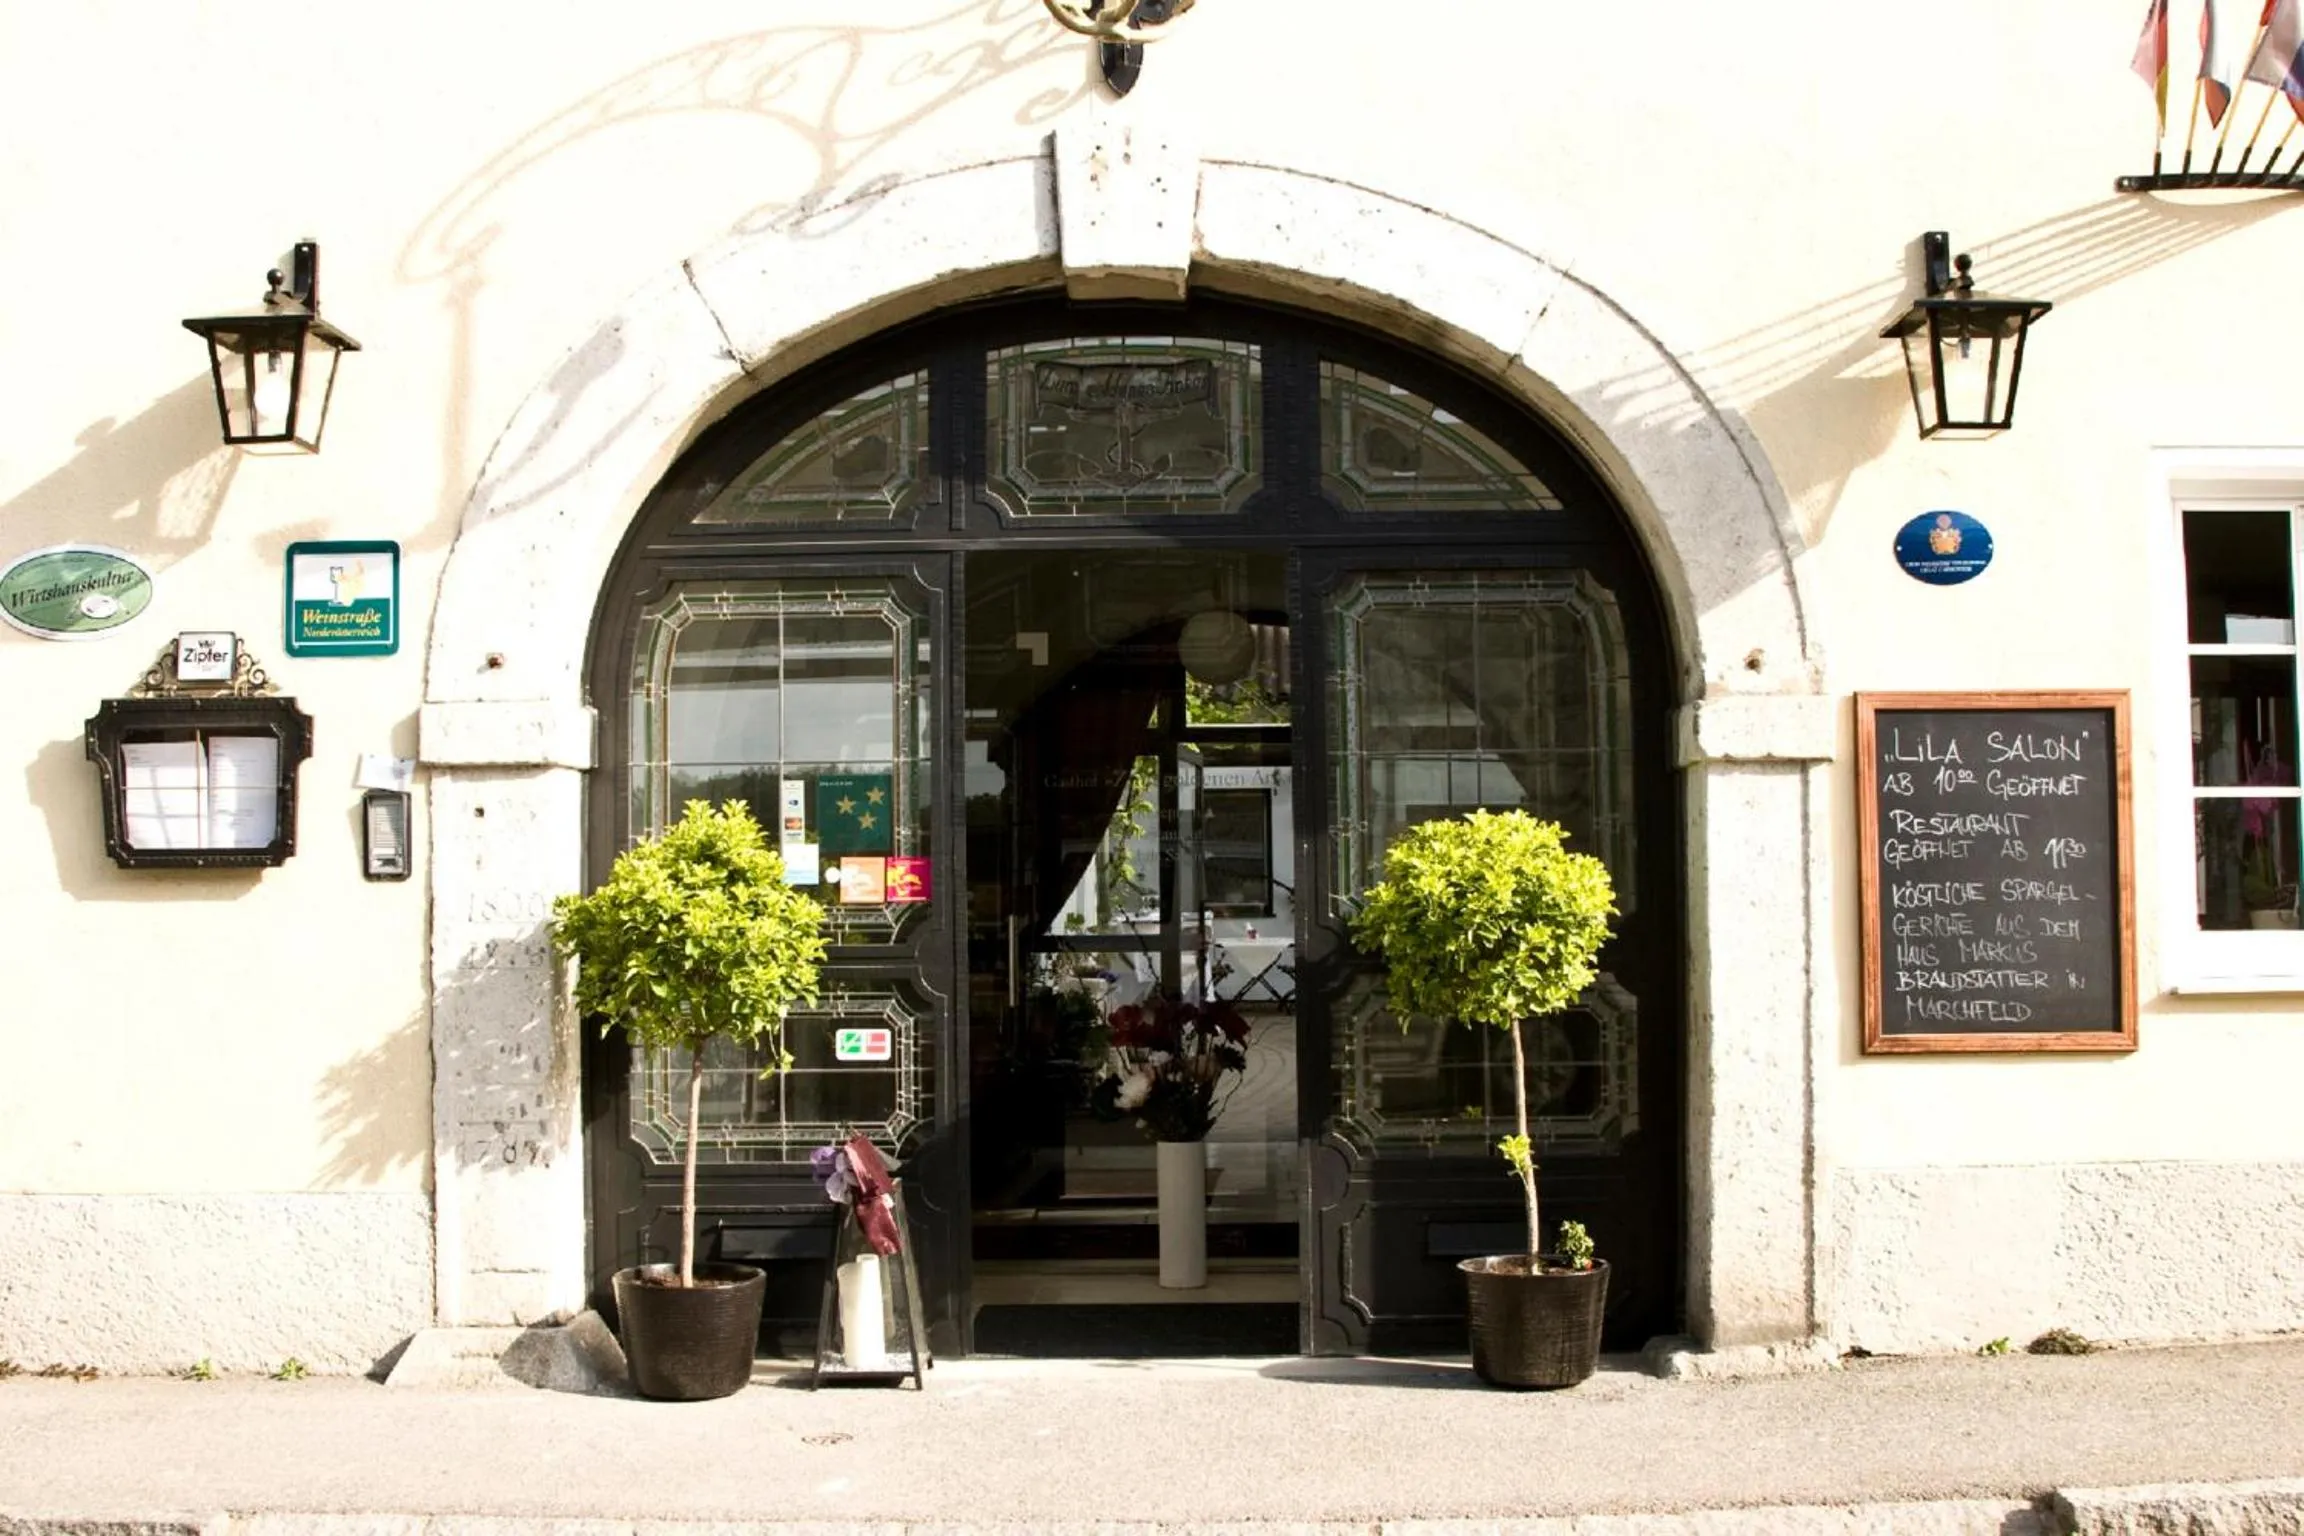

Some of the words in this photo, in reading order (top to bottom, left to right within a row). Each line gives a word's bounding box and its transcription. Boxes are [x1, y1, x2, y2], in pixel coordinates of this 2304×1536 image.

[11, 569, 135, 608] Wirtshauskultur
[302, 607, 382, 628] Weinstraße
[183, 646, 229, 664] Zipfer
[1882, 771, 1915, 795] AB
[1986, 768, 2088, 800] GEÖFFNET
[1889, 809, 2031, 837] RESTAURANT
[1884, 838, 1976, 871] GEÖFFNET
[2000, 839, 2029, 862] AB
[1892, 880, 1987, 909] KÖSTLICHE
[1892, 912, 1975, 943] GERICHTE
[1994, 912, 2032, 939] AUS
[2039, 917, 2081, 942] DEM
[1896, 942, 1941, 969] HAUS
[1957, 937, 2038, 964] MARKUS
[1905, 994, 2032, 1023] MARCHFELD
